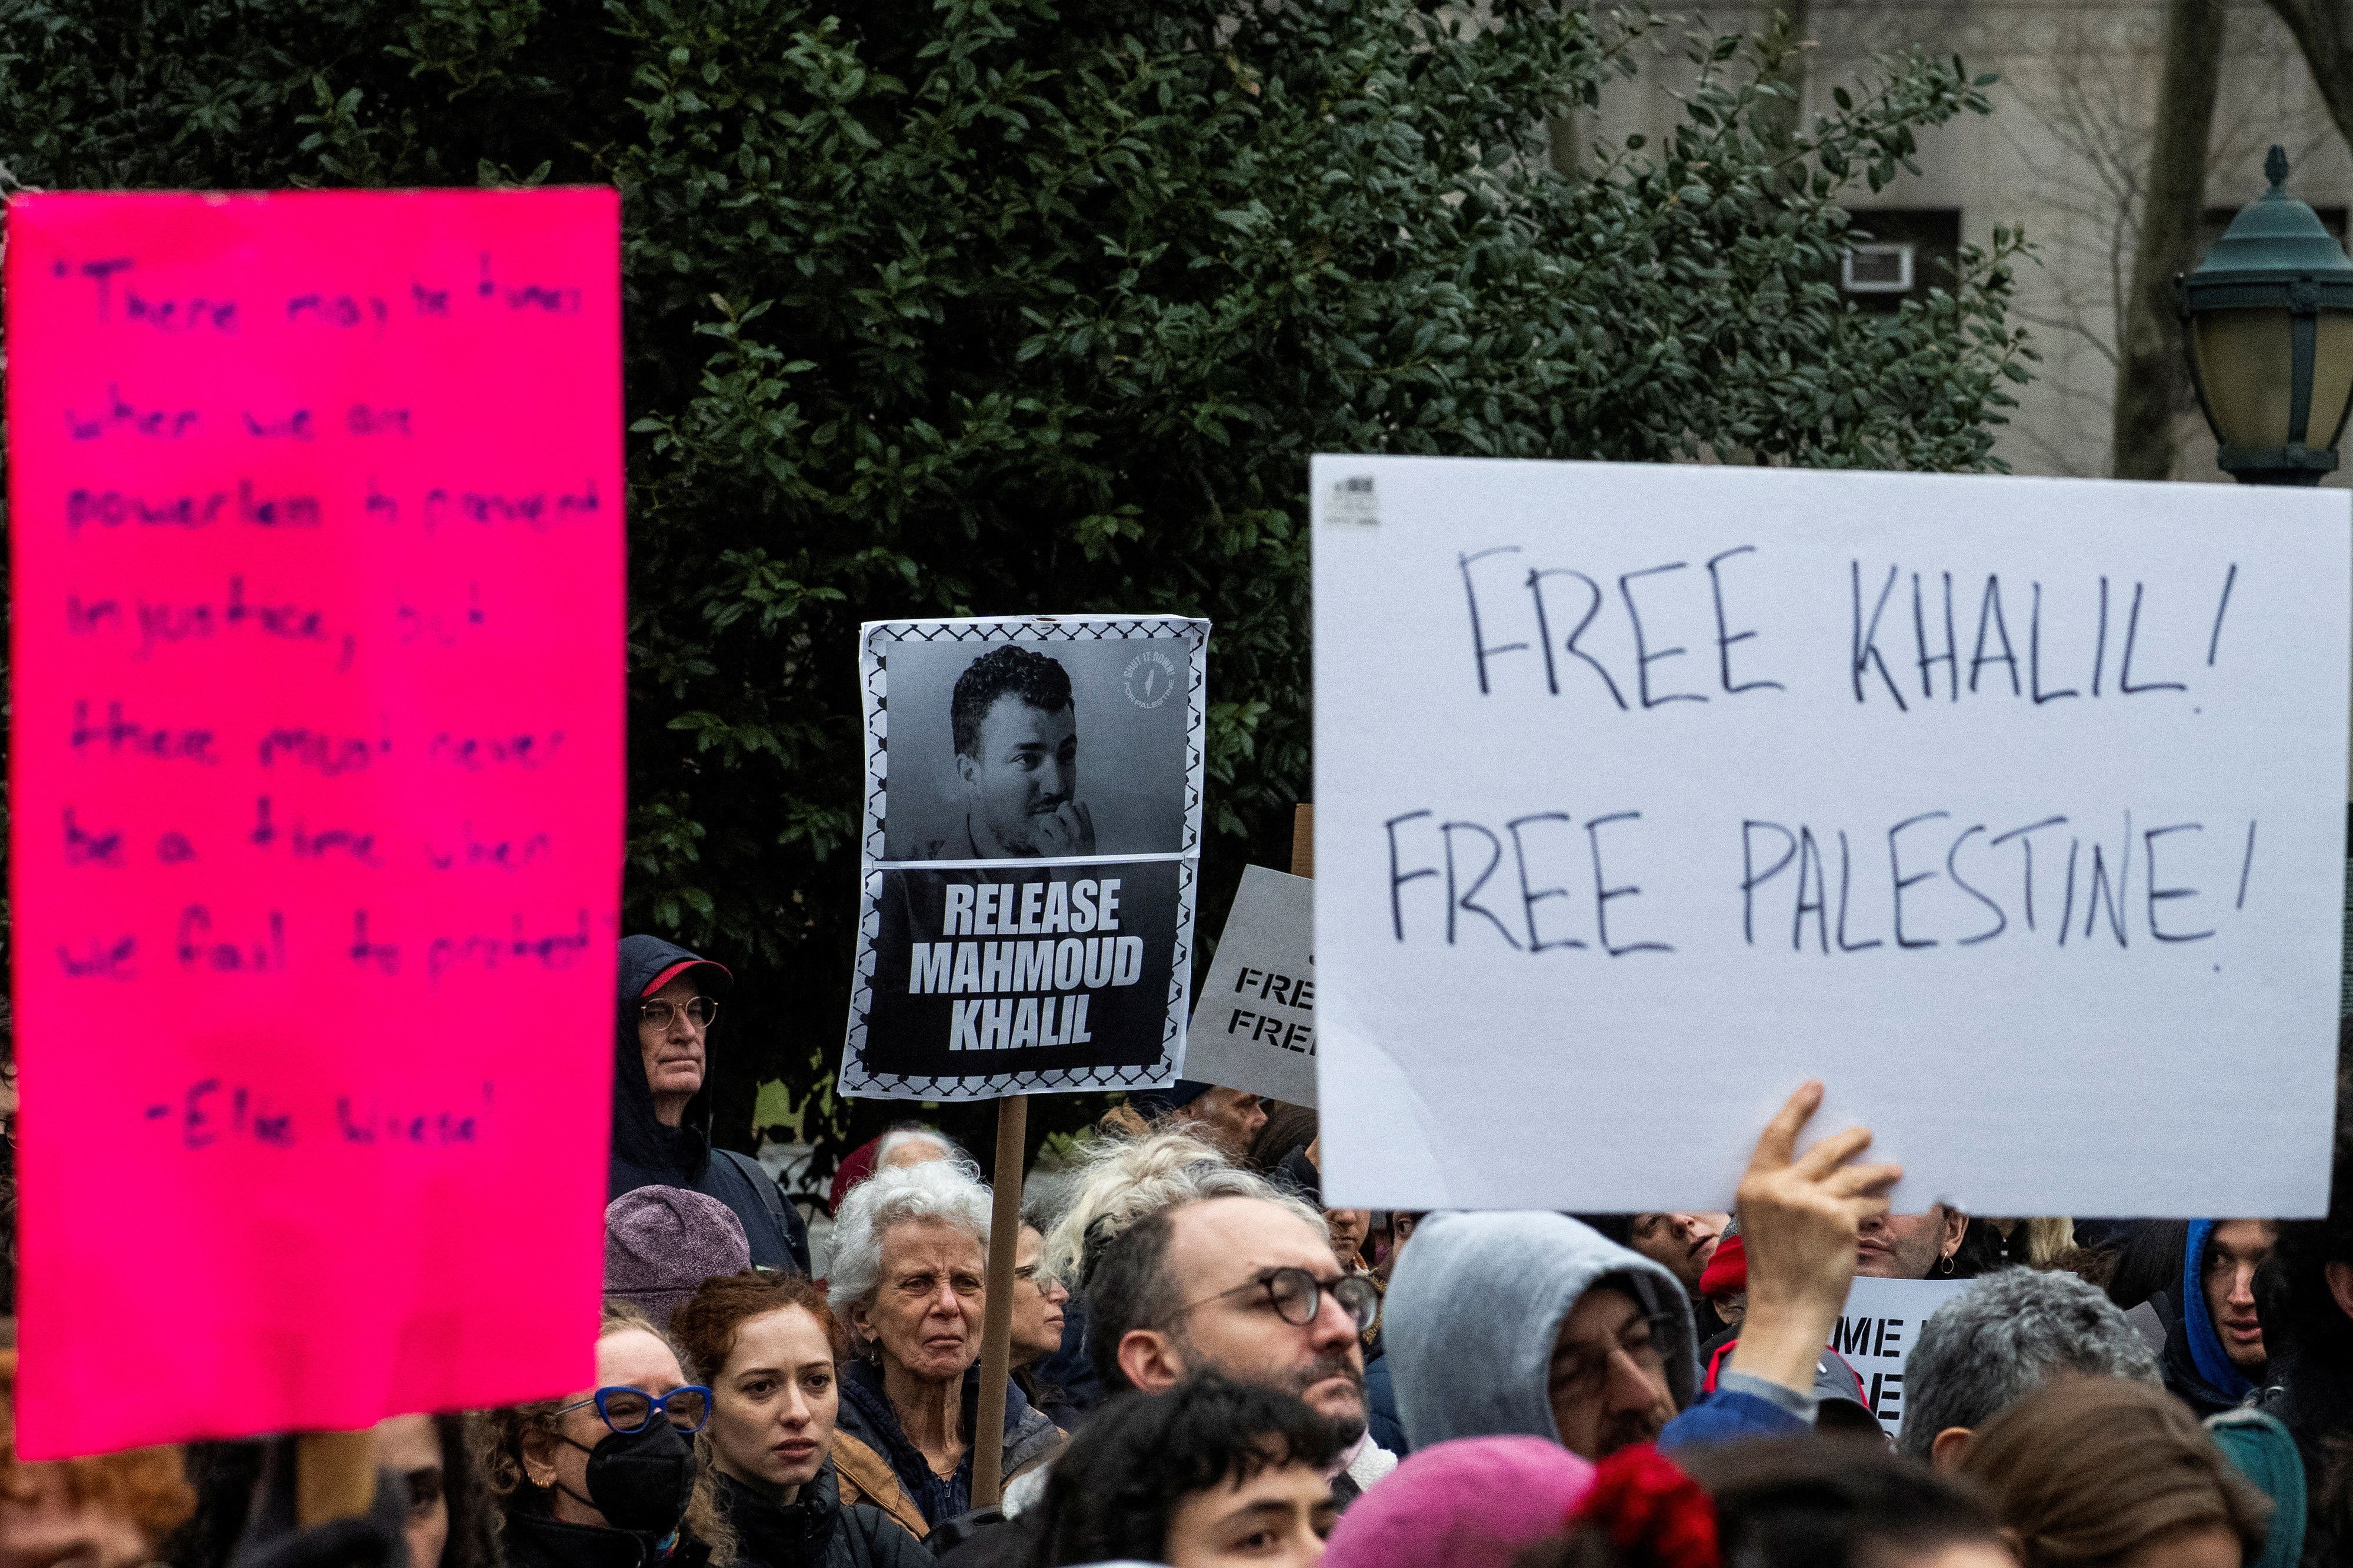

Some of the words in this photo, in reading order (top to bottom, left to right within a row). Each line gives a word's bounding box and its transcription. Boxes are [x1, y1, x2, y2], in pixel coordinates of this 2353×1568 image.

[65, 380, 200, 441] when
[241, 407, 316, 442] we
[345, 403, 415, 439] are
[65, 476, 323, 542] powerless
[364, 473, 401, 526] to
[422, 475, 601, 542] prevent
[1459, 543, 1787, 712] FREE
[1851, 557, 2239, 716] KHALIL!
[1134, 678, 1175, 709] PALESTINE
[69, 697, 222, 768] there
[258, 709, 393, 778] must
[428, 725, 567, 772] never
[60, 803, 125, 869] be
[155, 829, 198, 867] a
[249, 793, 387, 870] time
[422, 818, 552, 872] when
[942, 878, 1122, 936] RELEASE
[1384, 807, 1677, 959] FREE
[1739, 807, 2258, 975] PALESTINE!
[55, 933, 140, 983] we
[176, 902, 287, 973] fail
[348, 906, 401, 977] to
[908, 935, 1144, 995] MAHMOUD
[948, 994, 1092, 1052] KHALIL
[1227, 1009, 1317, 1056] FRE
